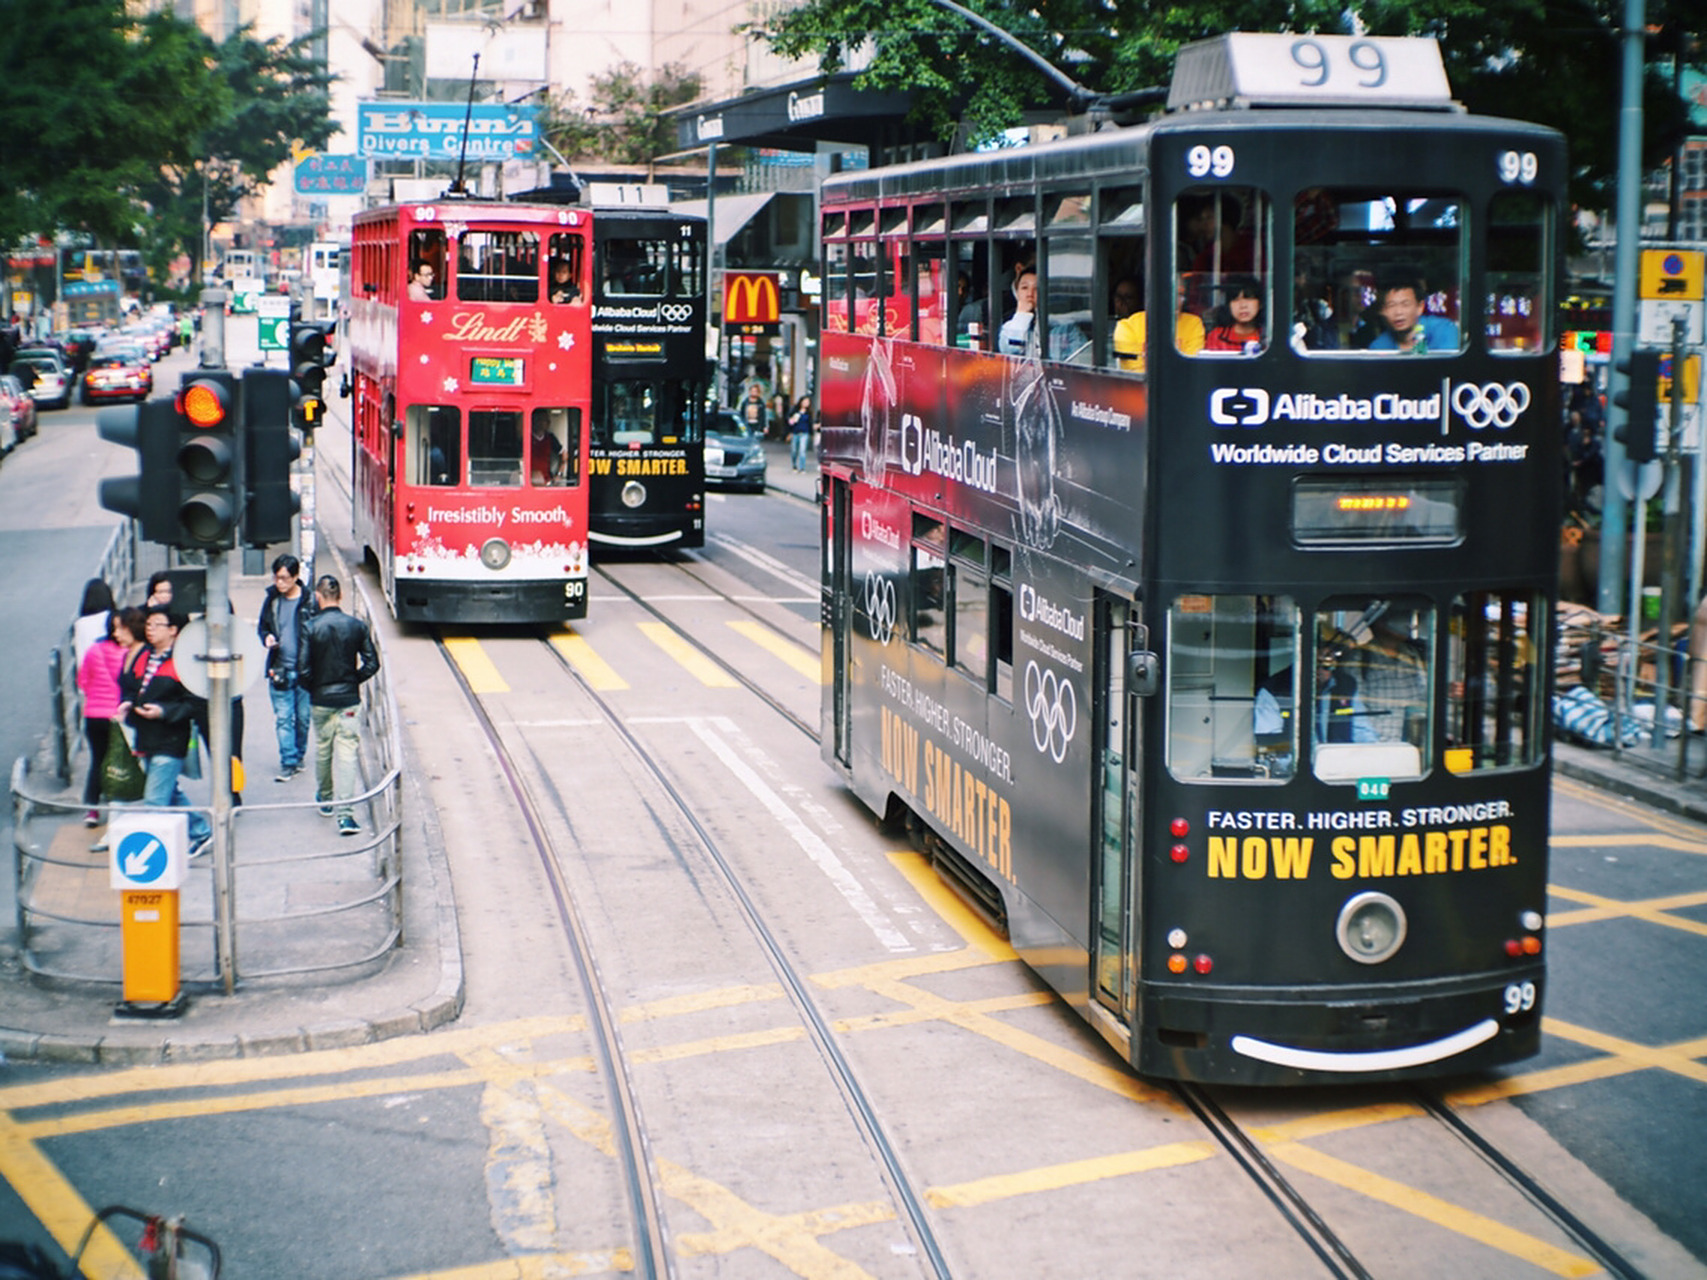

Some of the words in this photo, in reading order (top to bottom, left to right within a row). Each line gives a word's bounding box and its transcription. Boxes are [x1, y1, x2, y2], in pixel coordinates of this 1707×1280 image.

[1291, 38, 1390, 88] 99
[363, 112, 533, 135] Bunn's
[363, 135, 430, 151] Divers
[443, 136, 514, 151] Centre
[1188, 146, 1234, 178] 99
[1501, 151, 1538, 183] 99
[618, 185, 645, 205] 11
[415, 207, 436, 222] 90
[558, 211, 578, 226] 90
[680, 225, 691, 236] 11
[442, 312, 527, 343] Lindt
[1211, 443, 1318, 464] Worldwide
[1323, 443, 1382, 463] Cloud
[1385, 443, 1466, 463] Services
[1467, 441, 1529, 461] Partner
[617, 459, 690, 476] SMARTER.
[428, 506, 506, 527] Irresistibly
[511, 506, 567, 524] Smooth
[565, 582, 584, 598] 90
[953, 717, 1015, 786] STRONGER.
[881, 705, 918, 797] NOW
[924, 740, 1017, 885] SMARTER.
[1360, 782, 1389, 796] 040
[1208, 811, 1304, 829] FASTER.
[1308, 811, 1400, 829] HIGHER.
[1402, 801, 1515, 826] STRONGER.
[1207, 836, 1314, 879] NOW
[1331, 825, 1519, 880] SMARTER.
[1504, 982, 1536, 1014] 99
